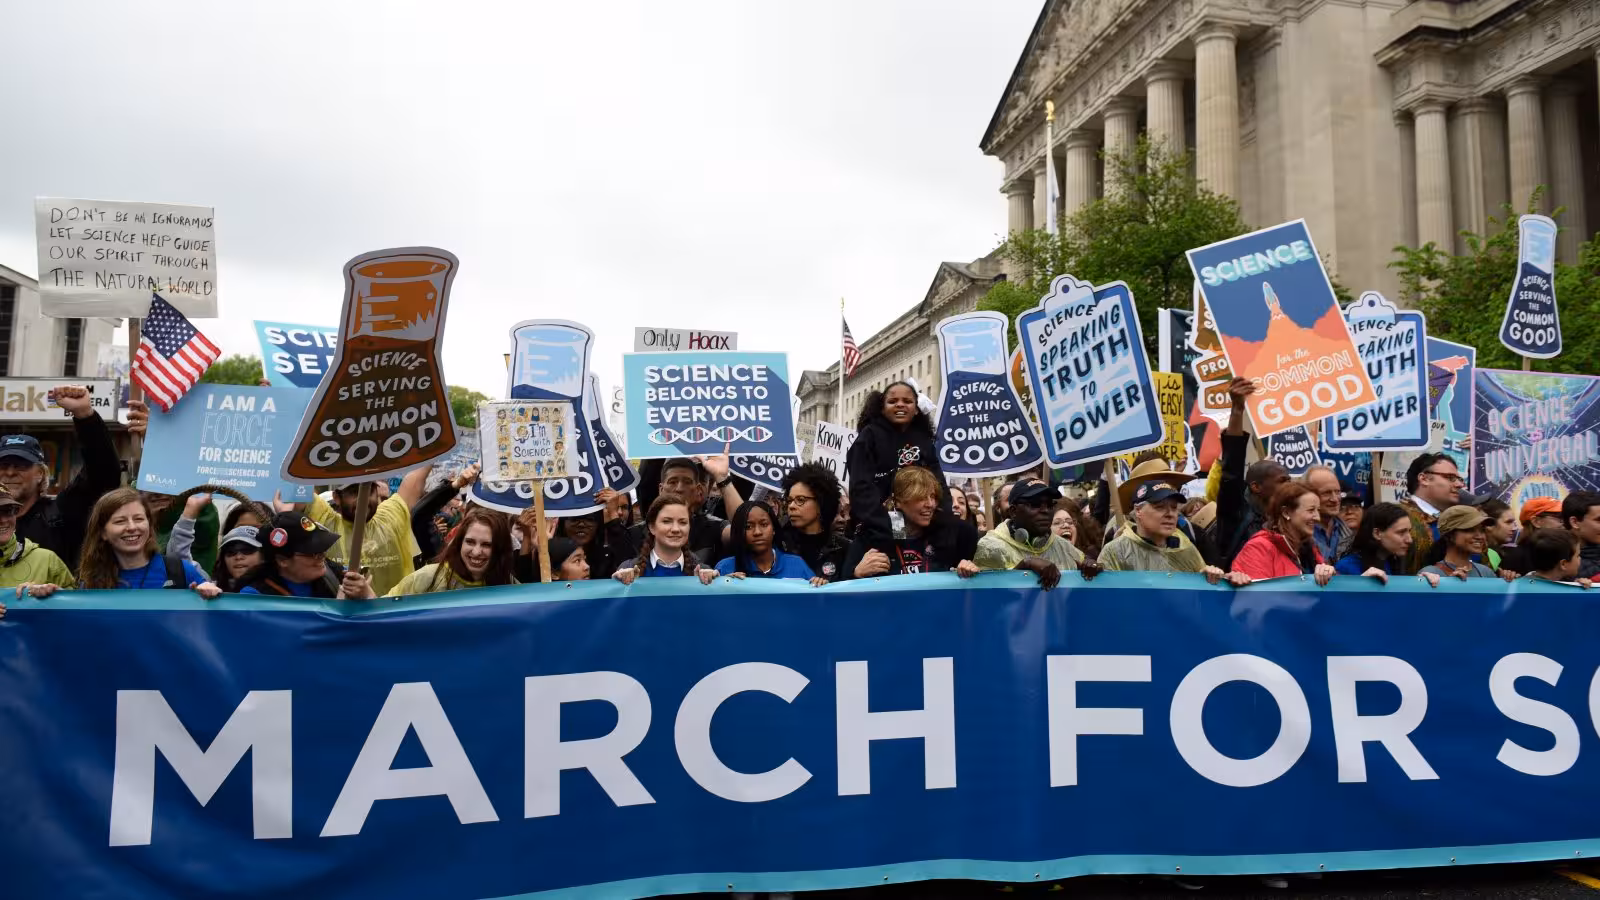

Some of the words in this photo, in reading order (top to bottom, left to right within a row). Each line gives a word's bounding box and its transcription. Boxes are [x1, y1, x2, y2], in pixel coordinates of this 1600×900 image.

[50, 206, 106, 224] DON'T
[115, 211, 129, 223] BE
[134, 213, 146, 224] AN
[152, 213, 213, 228] IGNORAMUS
[50, 227, 74, 240] LET
[83, 228, 136, 245] SCIENCE
[142, 233, 171, 249] HELP
[173, 237, 210, 252] GUIDE
[49, 245, 87, 261] OUR
[95, 247, 145, 263] SPIRIT
[152, 254, 209, 271] THROUGH
[1201, 240, 1312, 285] SCIENCE
[50, 267, 84, 288] THE
[95, 270, 164, 293] NATURAL
[168, 279, 213, 296] WORLD
[1522, 275, 1550, 291] SCIENCE
[1519, 290, 1552, 305] SERVING
[1528, 302, 1540, 311] THE
[1037, 304, 1097, 348] SCIENCE
[1350, 319, 1394, 335] IENCE
[1513, 309, 1554, 326] COMMON
[264, 326, 338, 349] SCIE
[643, 329, 680, 351] Only
[688, 331, 730, 350] Hoax
[1040, 304, 1120, 372] SPEAKING
[1358, 328, 1414, 358] EAKING
[1509, 322, 1556, 346] GOOD
[348, 351, 428, 378] SCIENCE
[1042, 328, 1129, 398] TRUTH
[1276, 353, 1293, 369] for
[1295, 347, 1310, 358] the
[1367, 348, 1416, 380] UTH
[643, 364, 769, 384] SCIENCE
[1250, 350, 1354, 396] COMMON
[338, 376, 432, 401] SERVING
[645, 386, 737, 402] BELONGS
[742, 386, 769, 400] TO
[952, 381, 1004, 400] SCIENCE
[1080, 380, 1096, 403] TO
[1257, 374, 1364, 425] GOOD
[206, 393, 214, 409] I
[219, 394, 256, 412] AM
[261, 397, 277, 412] A
[365, 396, 395, 410] THE
[949, 400, 1012, 417] SERVING
[320, 400, 438, 438] COMMON
[646, 405, 772, 424] EVERYONE
[968, 412, 989, 424] THE
[1055, 383, 1141, 450] POWER
[1337, 395, 1418, 437] POWER
[201, 411, 277, 448] FORCE
[529, 423, 546, 438] I'm
[943, 418, 1022, 443] COMMON
[308, 422, 443, 467] GOOD
[532, 436, 551, 447] with
[939, 434, 1029, 466] GOOD
[1274, 439, 1310, 453] COMMON
[199, 446, 222, 463] FOR
[224, 448, 272, 465] SCIENCE
[1274, 450, 1313, 469] GOOD
[1485, 430, 1600, 484] UNIVERSAL
[109, 657, 957, 848] MARCH
[1046, 653, 1440, 787] FOR
[1488, 652, 1600, 777] S
